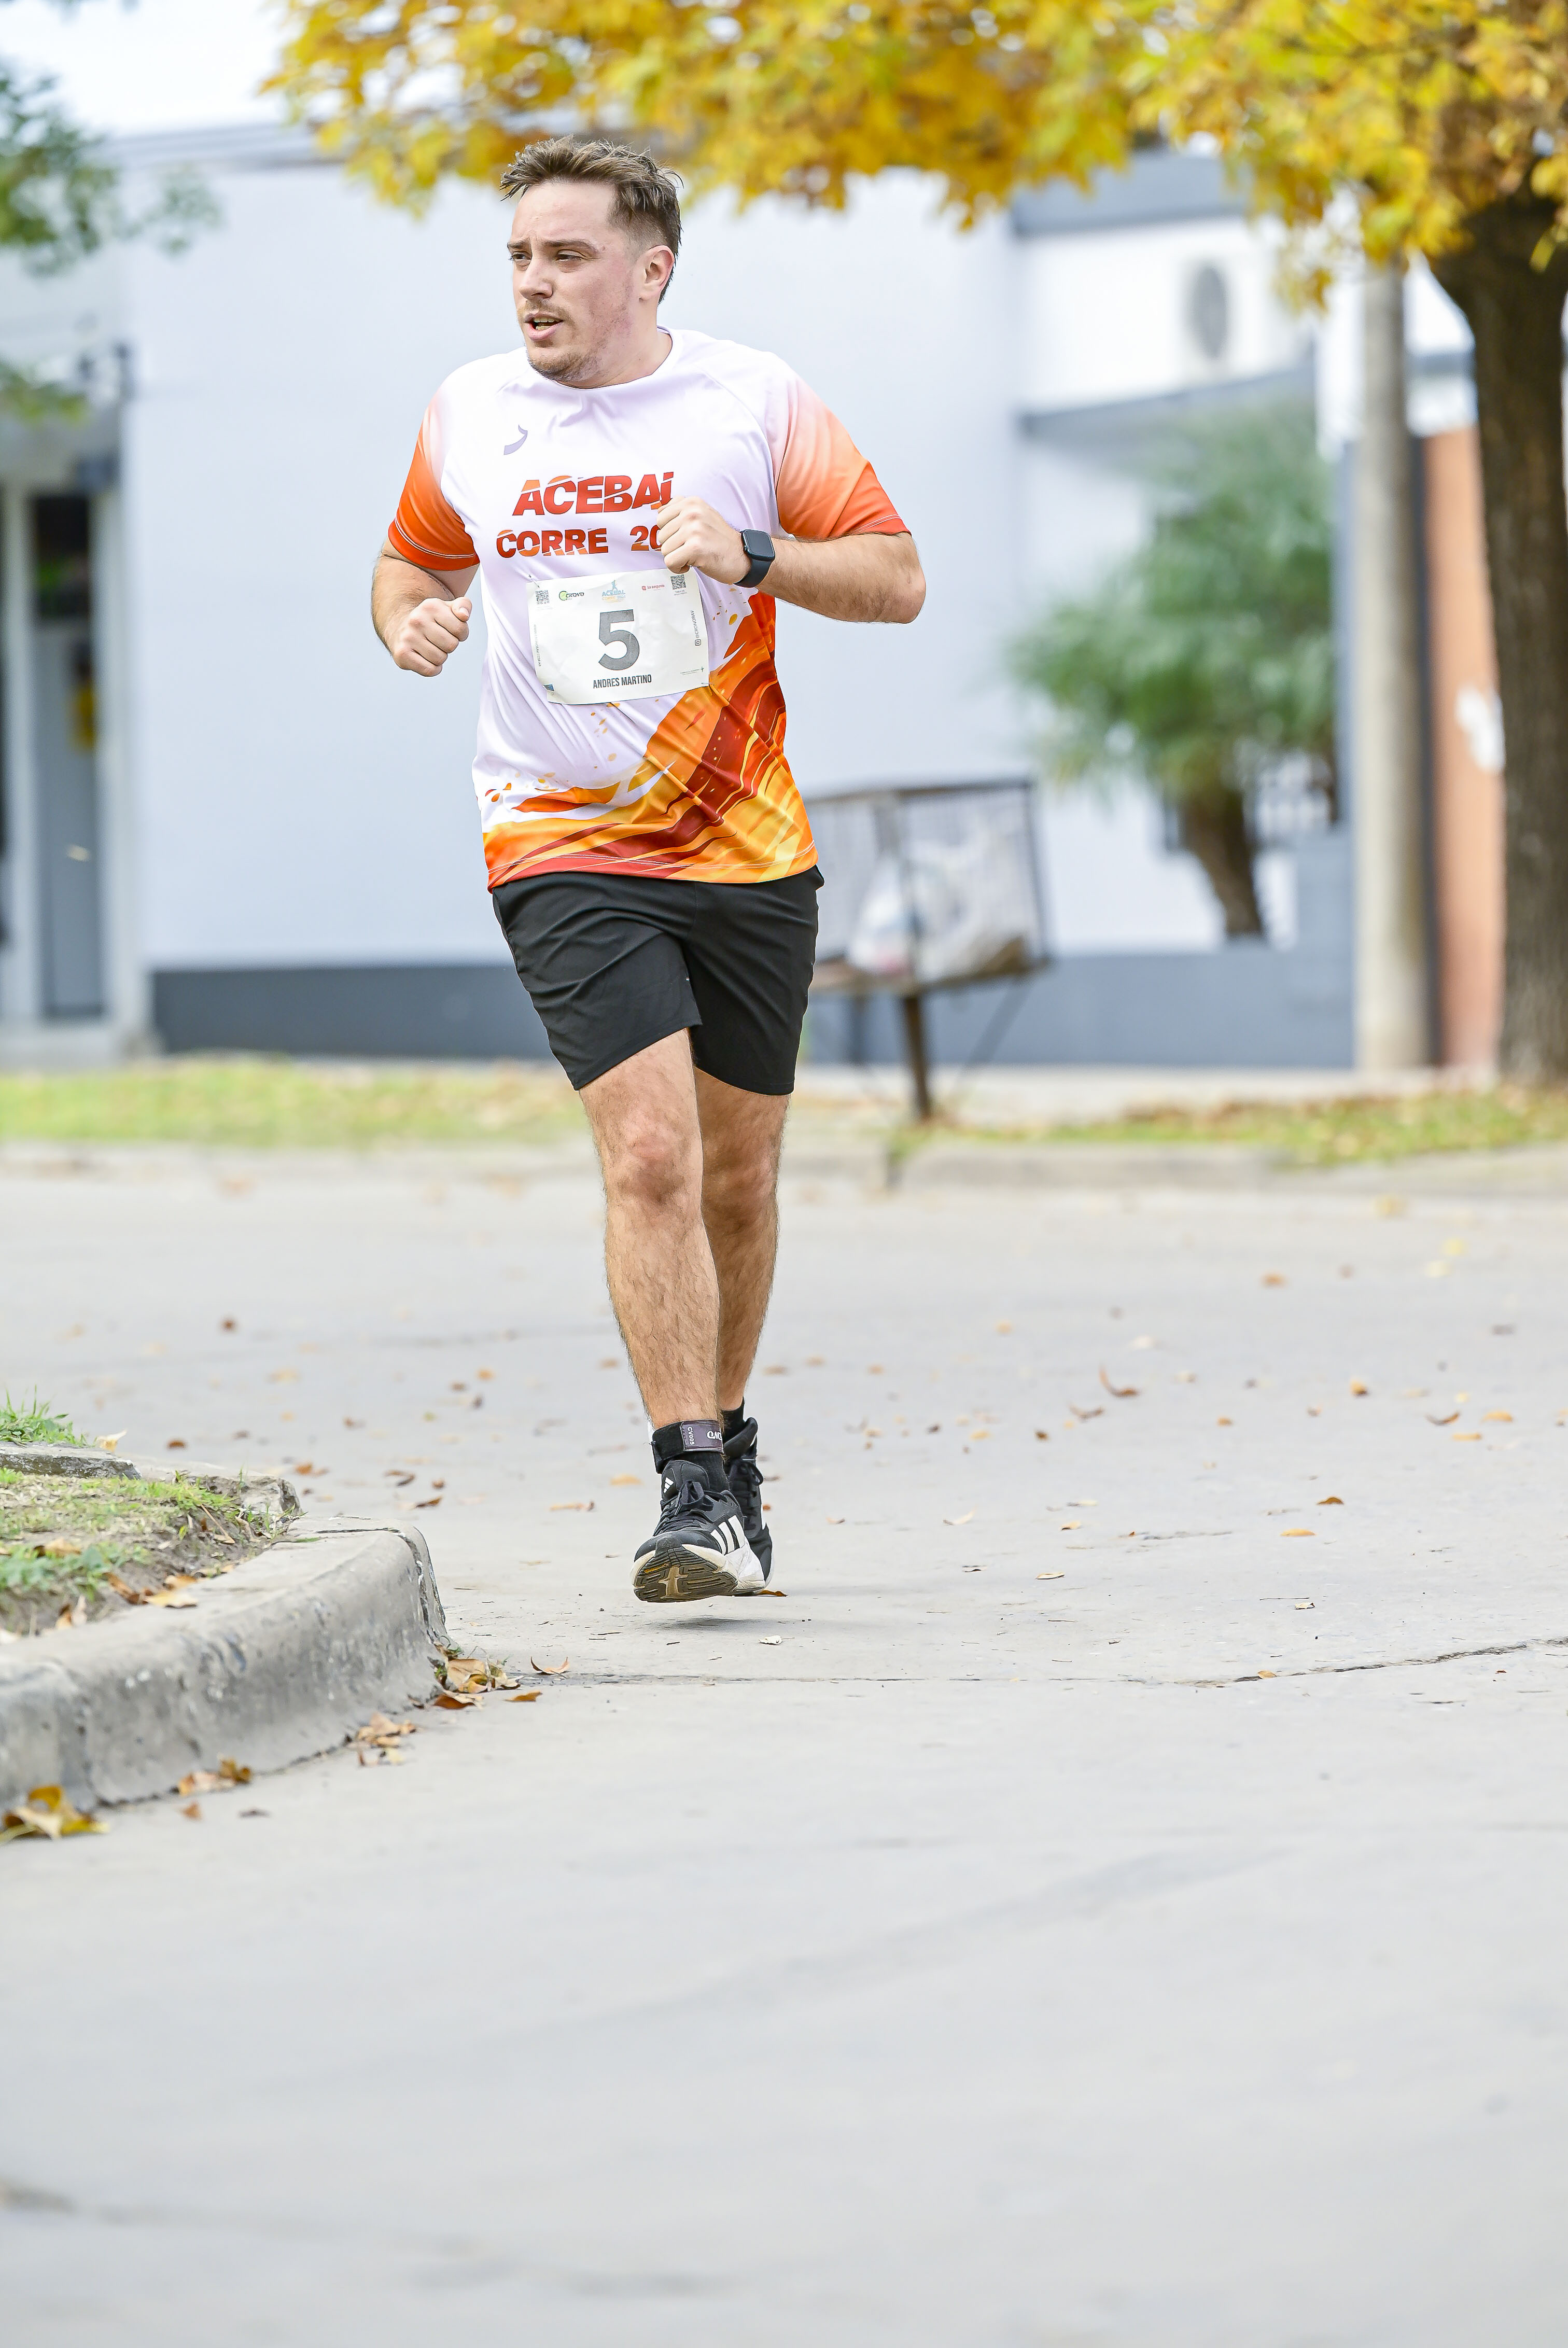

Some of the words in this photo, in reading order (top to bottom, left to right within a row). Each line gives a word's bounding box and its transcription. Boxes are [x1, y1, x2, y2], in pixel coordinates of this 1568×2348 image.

[496, 528, 608, 558] CORRE
[598, 609, 640, 670] 5
[593, 677, 620, 689] ANDRES
[621, 674, 652, 686] MARTINO
